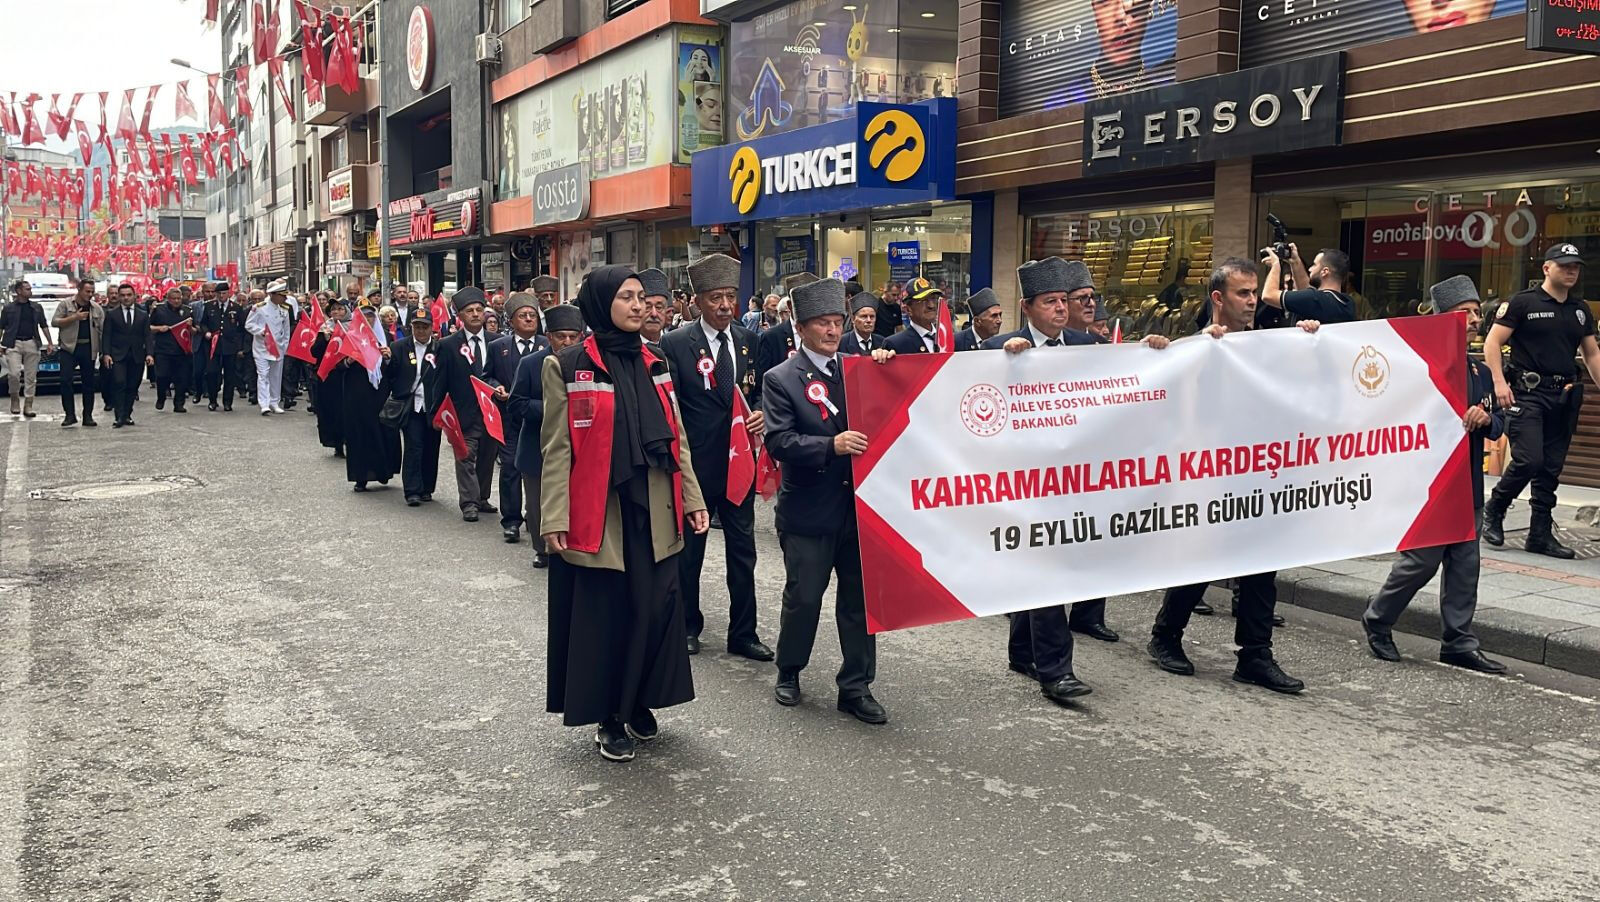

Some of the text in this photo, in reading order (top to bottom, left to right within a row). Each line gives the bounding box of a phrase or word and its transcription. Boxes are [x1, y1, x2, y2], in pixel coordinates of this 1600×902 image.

[783, 45, 821, 55] AKSESUAR
[1009, 24, 1082, 55] CETAŞ
[1143, 85, 1323, 145] ERSOY
[536, 172, 577, 210] cossta
[1068, 215, 1167, 240] ERSOY
[1008, 375, 1140, 396] TÜRKİYE CUMHURİYETİ
[1010, 389, 1167, 413] AİLE VE SOSYAL HİZMETLER
[1012, 413, 1077, 430] BAKANLIĞI
[911, 423, 1430, 510] KAHRAMANLARLA KARDEŞLİK YOLUNDA
[990, 473, 1372, 552] 19 EYLÜL GAZİLER GÜNÜ YÜRÜYÜŞÜ
